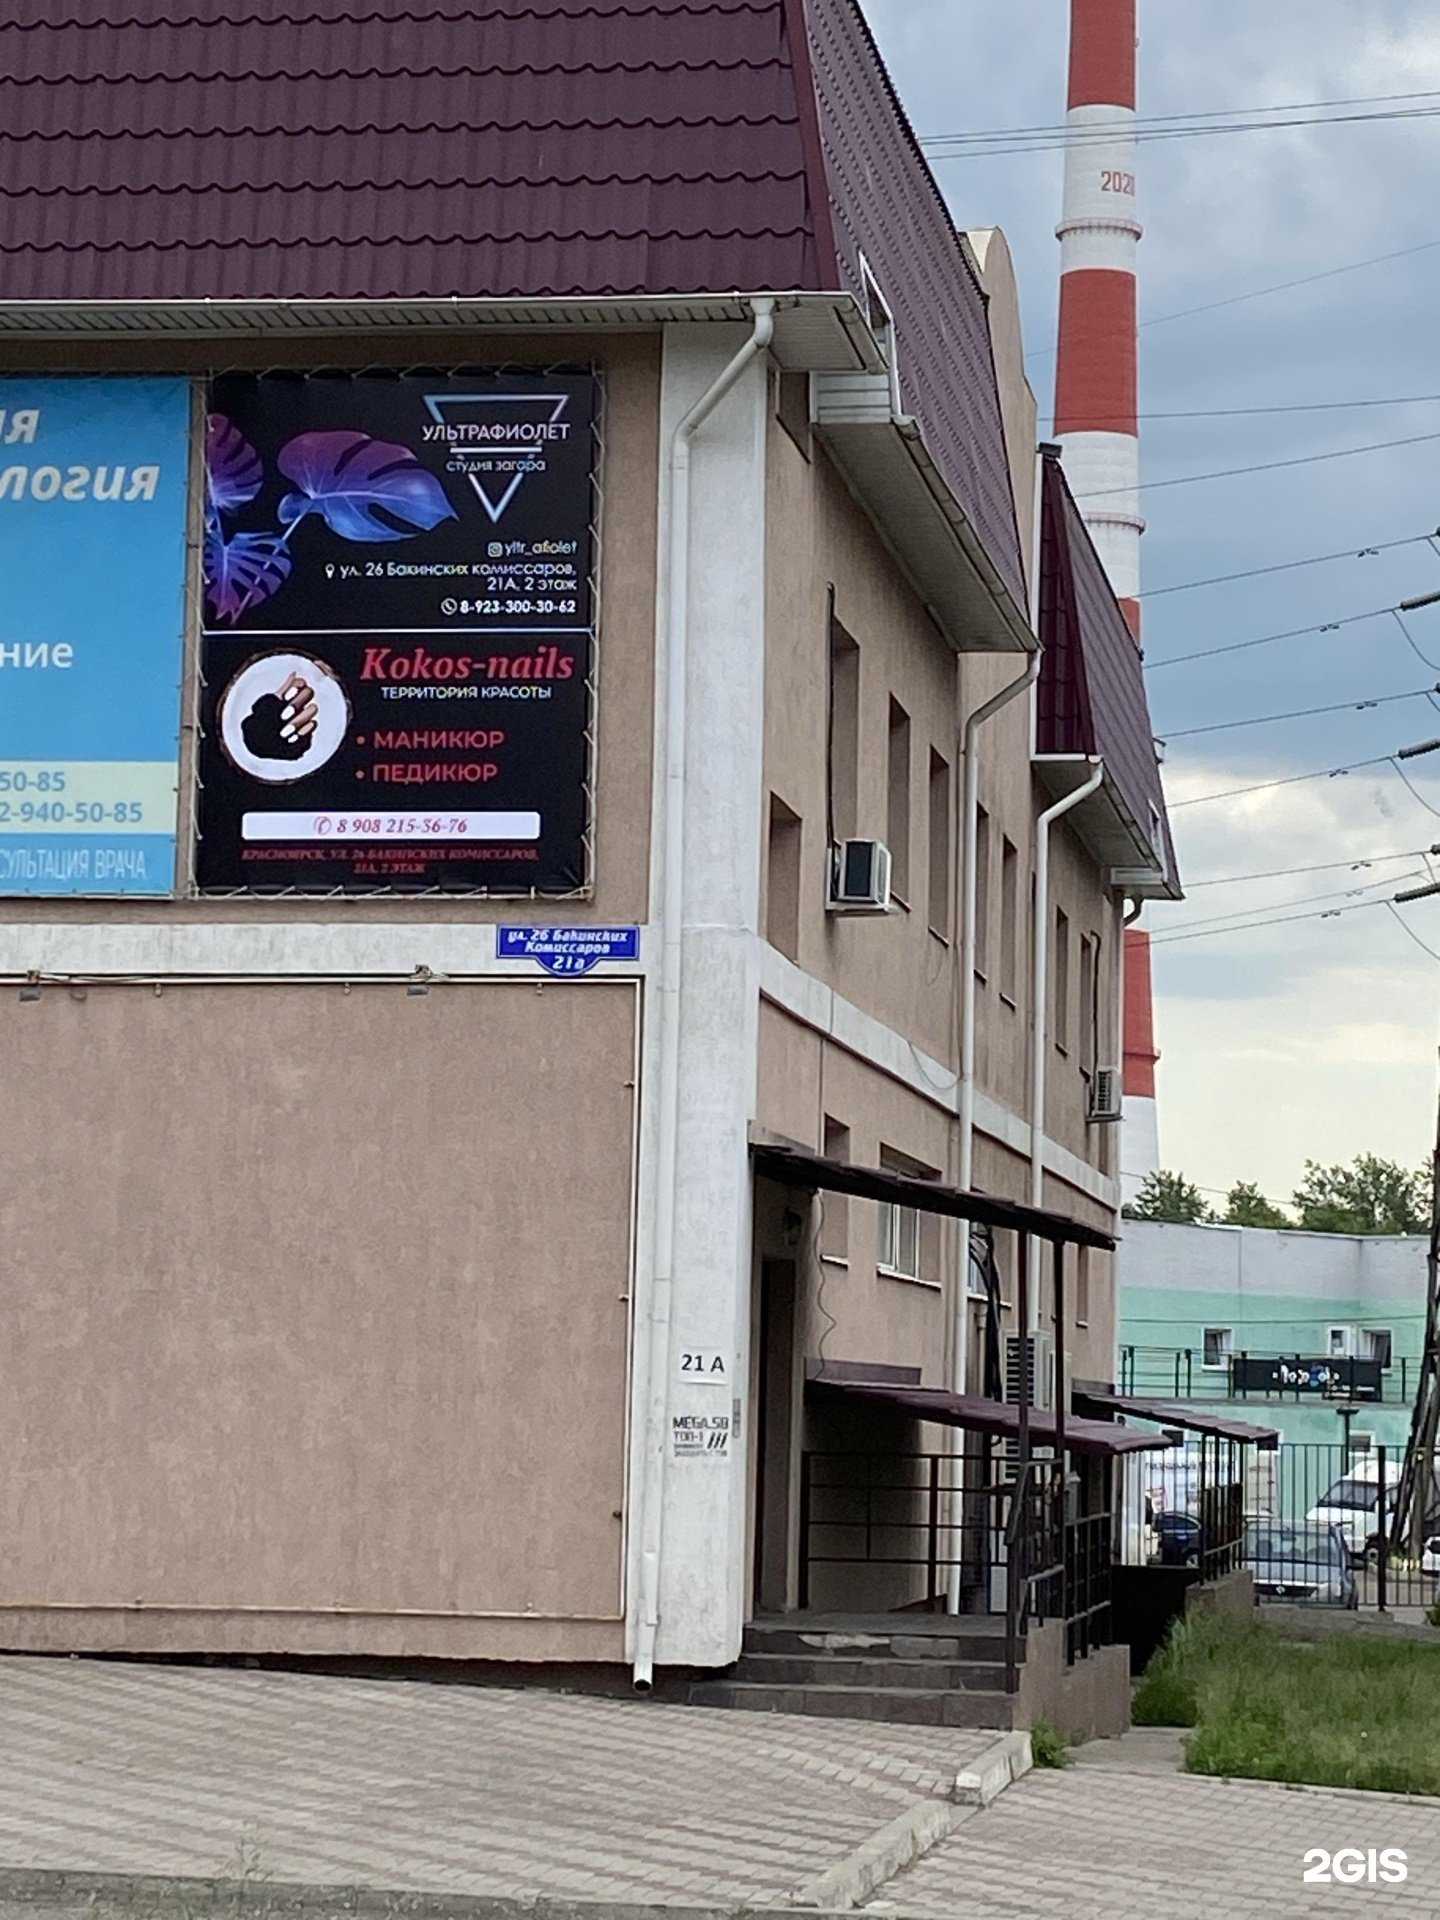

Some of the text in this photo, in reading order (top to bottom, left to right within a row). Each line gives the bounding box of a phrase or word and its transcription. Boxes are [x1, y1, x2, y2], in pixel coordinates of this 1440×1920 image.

[422, 424, 571, 441] УЛЬТРАФИОЛЕТ
[446, 460, 546, 473] студия загара
[339, 565, 362, 579] ул.
[365, 562, 384, 576] 26
[387, 562, 469, 577] Бакинских
[524, 577, 534, 591] 2
[537, 579, 577, 591] этаж
[460, 600, 576, 614] 8-923-300-30-62
[360, 646, 575, 681] Kokos-nails
[381, 685, 552, 700] ТЕРРИТОРИЯ КРАСОТЫ
[374, 731, 505, 749] МАНИКЮР
[372, 763, 498, 785] ПЕДИКЮР
[337, 818, 348, 834] 8
[352, 818, 381, 833] 908
[95, 850, 147, 880] ВРАЧА
[531, 929, 550, 942] 26
[552, 929, 628, 943] Бакинских
[525, 941, 610, 955] Комиссаров
[552, 955, 586, 970] 21а
[681, 1353, 705, 1372] 21
